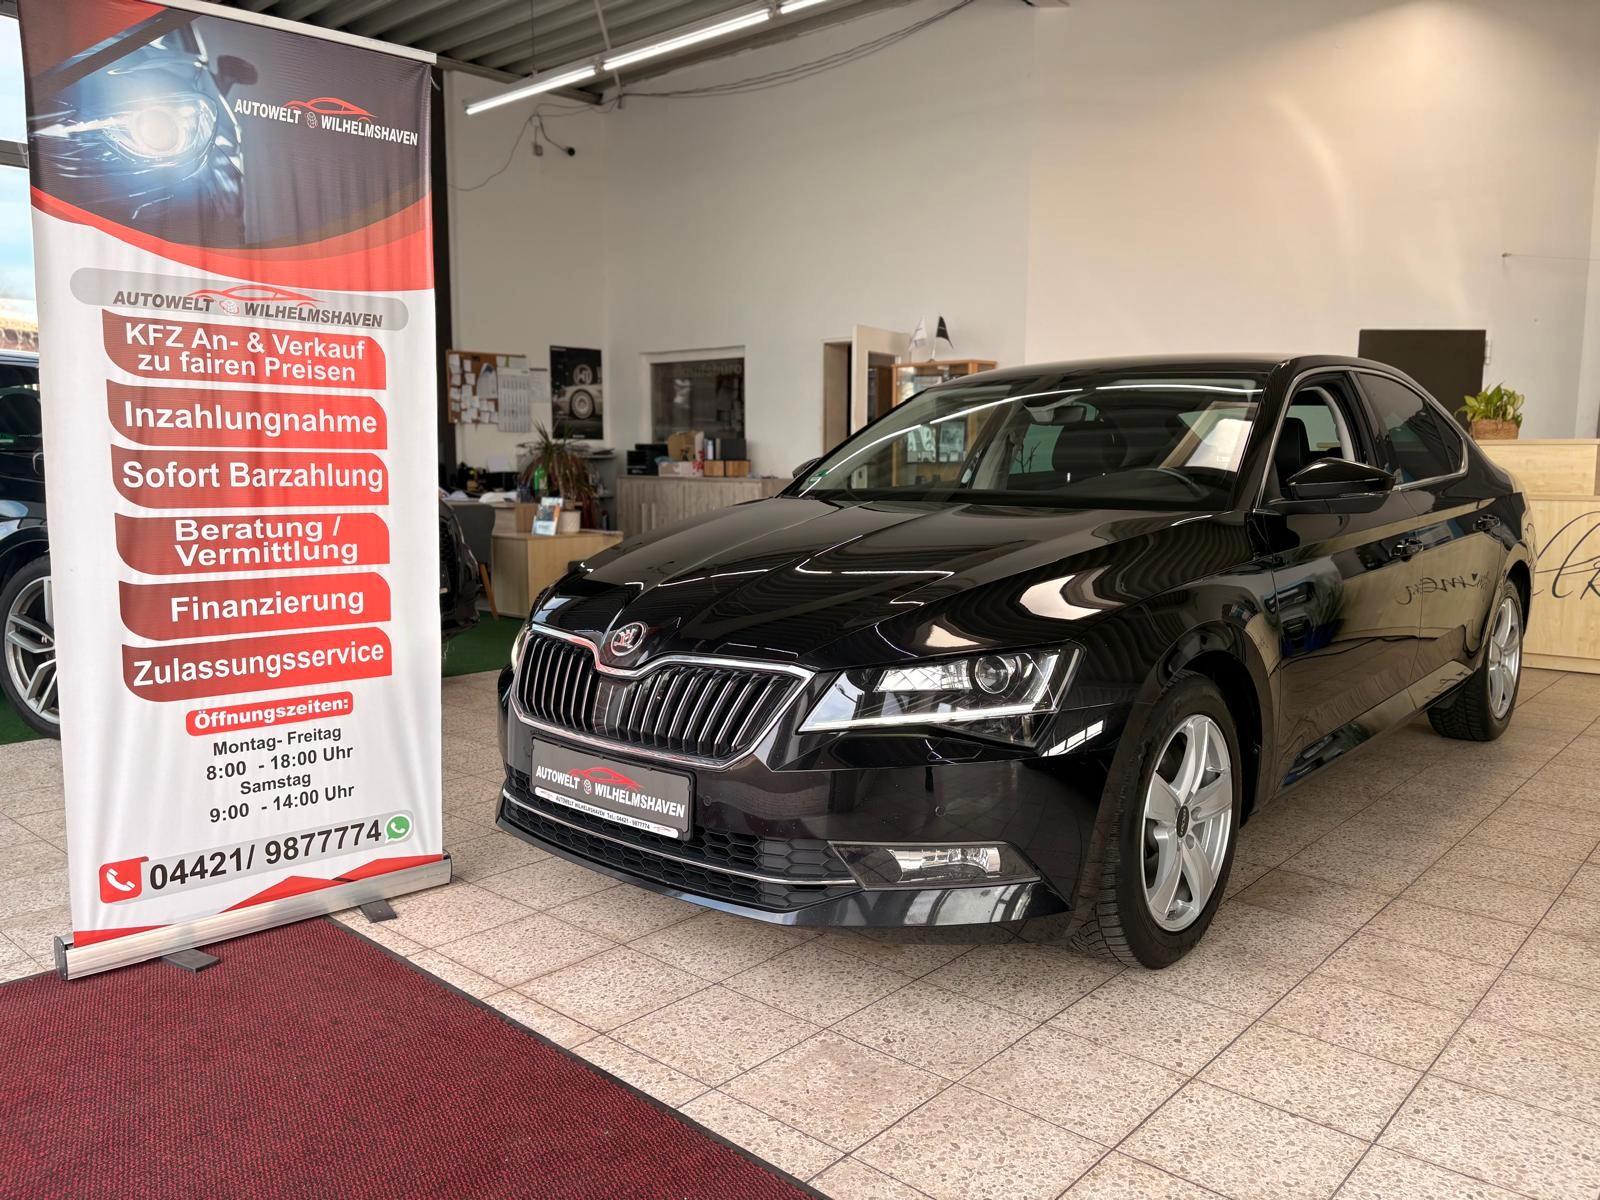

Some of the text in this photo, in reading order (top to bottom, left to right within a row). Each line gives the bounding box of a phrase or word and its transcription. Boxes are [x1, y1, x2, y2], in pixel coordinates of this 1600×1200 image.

[234, 98, 418, 146] AUTOWELT WILHELMSHAVEN
[113, 290, 383, 328] AUTOWELT WILHELMSHAVEN
[125, 322, 365, 360] KFZ An- & Verkauf
[138, 351, 355, 382] zu fairen Preisen
[124, 400, 377, 437] Inzahlungnahme
[123, 461, 383, 492] Sofort Barzahlung
[175, 516, 341, 543] Beratung /
[175, 541, 358, 567] Vermittlung
[171, 591, 364, 622] Finanzierung
[133, 641, 384, 687] Zulassungsservice
[195, 698, 349, 729] Öffnungszeiten:
[213, 726, 342, 756] Montag- Freitag
[206, 760, 247, 780] 8:00
[270, 749, 317, 771] 18:00
[323, 744, 353, 761] Uhr
[240, 773, 312, 795] Samstag
[535, 765, 686, 818] AUTOWELT WILHELMSHAVEN
[210, 802, 250, 823] 9:00
[273, 790, 319, 812] 14:00
[324, 784, 354, 803] Uhr
[555, 795, 574, 806] AUTOWELT
[574, 802, 605, 817] WILHELMSHAVEN
[149, 819, 382, 890] 04421/ 9877774
